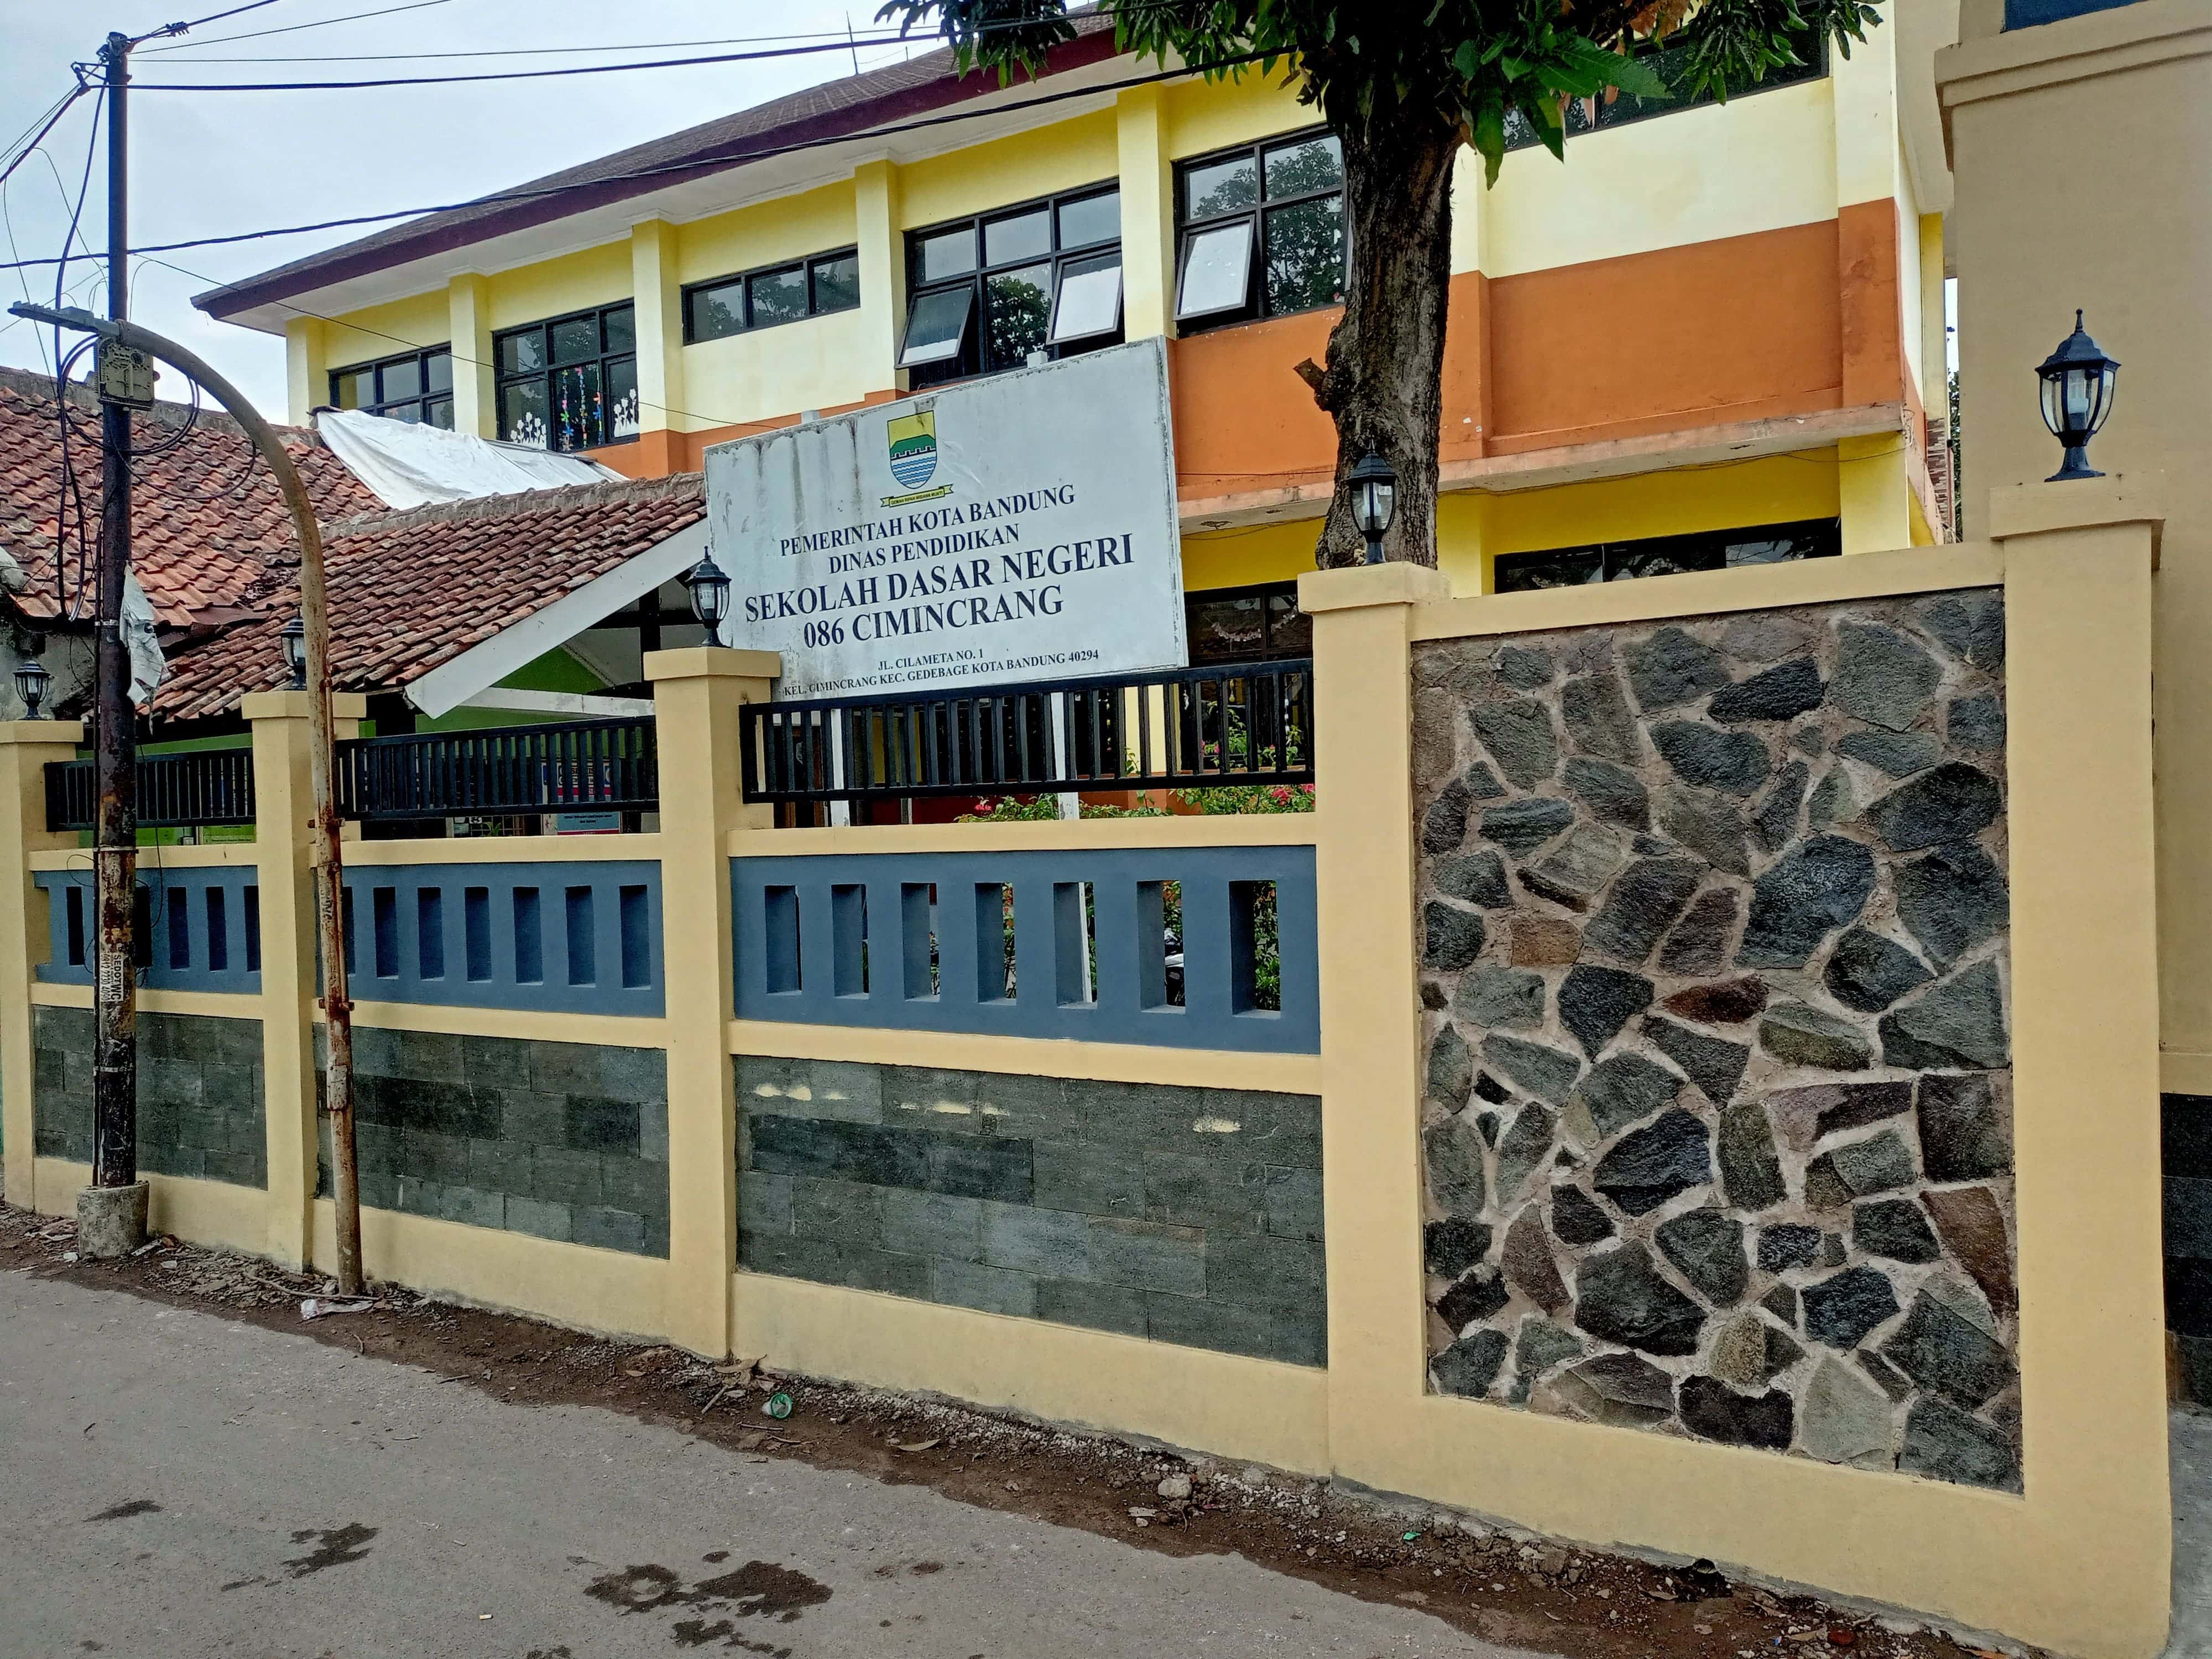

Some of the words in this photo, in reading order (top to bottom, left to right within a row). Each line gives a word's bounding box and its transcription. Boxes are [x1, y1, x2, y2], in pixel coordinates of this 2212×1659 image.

[780, 517, 903, 556] PEMERINTAH
[908, 507, 965, 533] KOTA
[969, 484, 1074, 522] BANDUNG
[828, 547, 886, 575] DINAS
[891, 523, 1019, 564] PENDIDIKAN
[745, 576, 880, 623] SEKOLAH
[886, 559, 994, 602] DASAR
[1000, 533, 1135, 583] NEGERI
[804, 617, 844, 648] 086
[852, 585, 1063, 641] CIMINCRANG
[784, 685, 806, 696] KEL.
[809, 676, 877, 693] CIMINCRANG
[880, 672, 905, 685] KEC.
[907, 664, 969, 681] GEDEBAGE
[972, 661, 1004, 674] KOTA
[1006, 653, 1065, 670] BANDUNG
[1068, 649, 1099, 662] 40294
[878, 661, 893, 671] JL.
[895, 653, 954, 669] CILAMETA
[956, 650, 975, 660] NO.
[979, 649, 983, 659] 1
